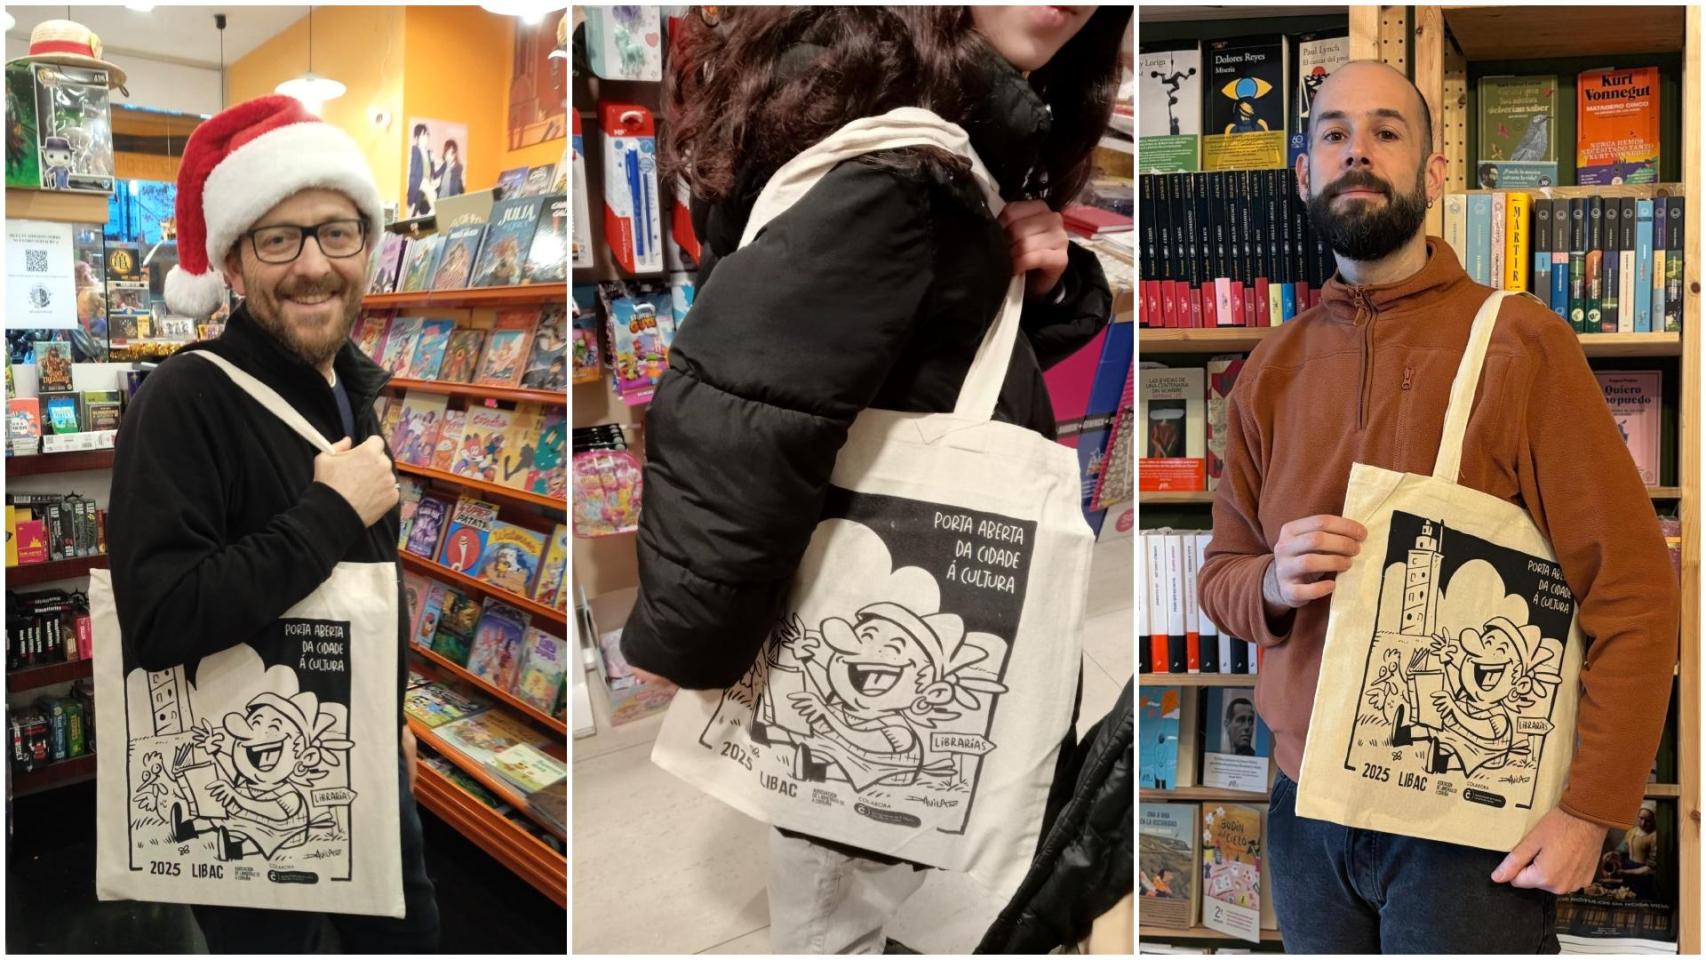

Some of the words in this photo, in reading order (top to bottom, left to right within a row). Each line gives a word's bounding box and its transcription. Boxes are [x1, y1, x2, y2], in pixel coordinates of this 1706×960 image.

[1215, 54, 1242, 64] Dolores
[1244, 52, 1266, 62] Reyes
[1602, 73, 1633, 88] Kurt
[1585, 86, 1651, 101] Vonnegut
[498, 203, 537, 226] JULIA
[1605, 385, 1642, 395] Quiero
[1617, 395, 1651, 407] puedo
[934, 511, 973, 534] PORTA
[977, 520, 1024, 545] ABERTA
[955, 539, 972, 559] DA
[977, 545, 1021, 569] CIDADE
[946, 559, 957, 581] Á
[960, 567, 1015, 594] CULTURA
[1527, 560, 1550, 576] PORTA
[1538, 579, 1549, 592] DA
[1532, 591, 1539, 605] Á
[1540, 596, 1570, 614] CULTURA
[285, 623, 312, 636] PORTA
[314, 624, 344, 638] ABERTA
[302, 640, 314, 653] DA
[316, 642, 344, 655] CIDADE
[299, 654, 306, 670] Á
[308, 657, 345, 672] CULTURA
[720, 741, 753, 771] 2025
[760, 770, 798, 798] LIBAC
[1362, 762, 1391, 782] 2025
[1398, 771, 1428, 791] LIBAC
[150, 861, 181, 876] 2025
[192, 863, 224, 879] LIBAC
